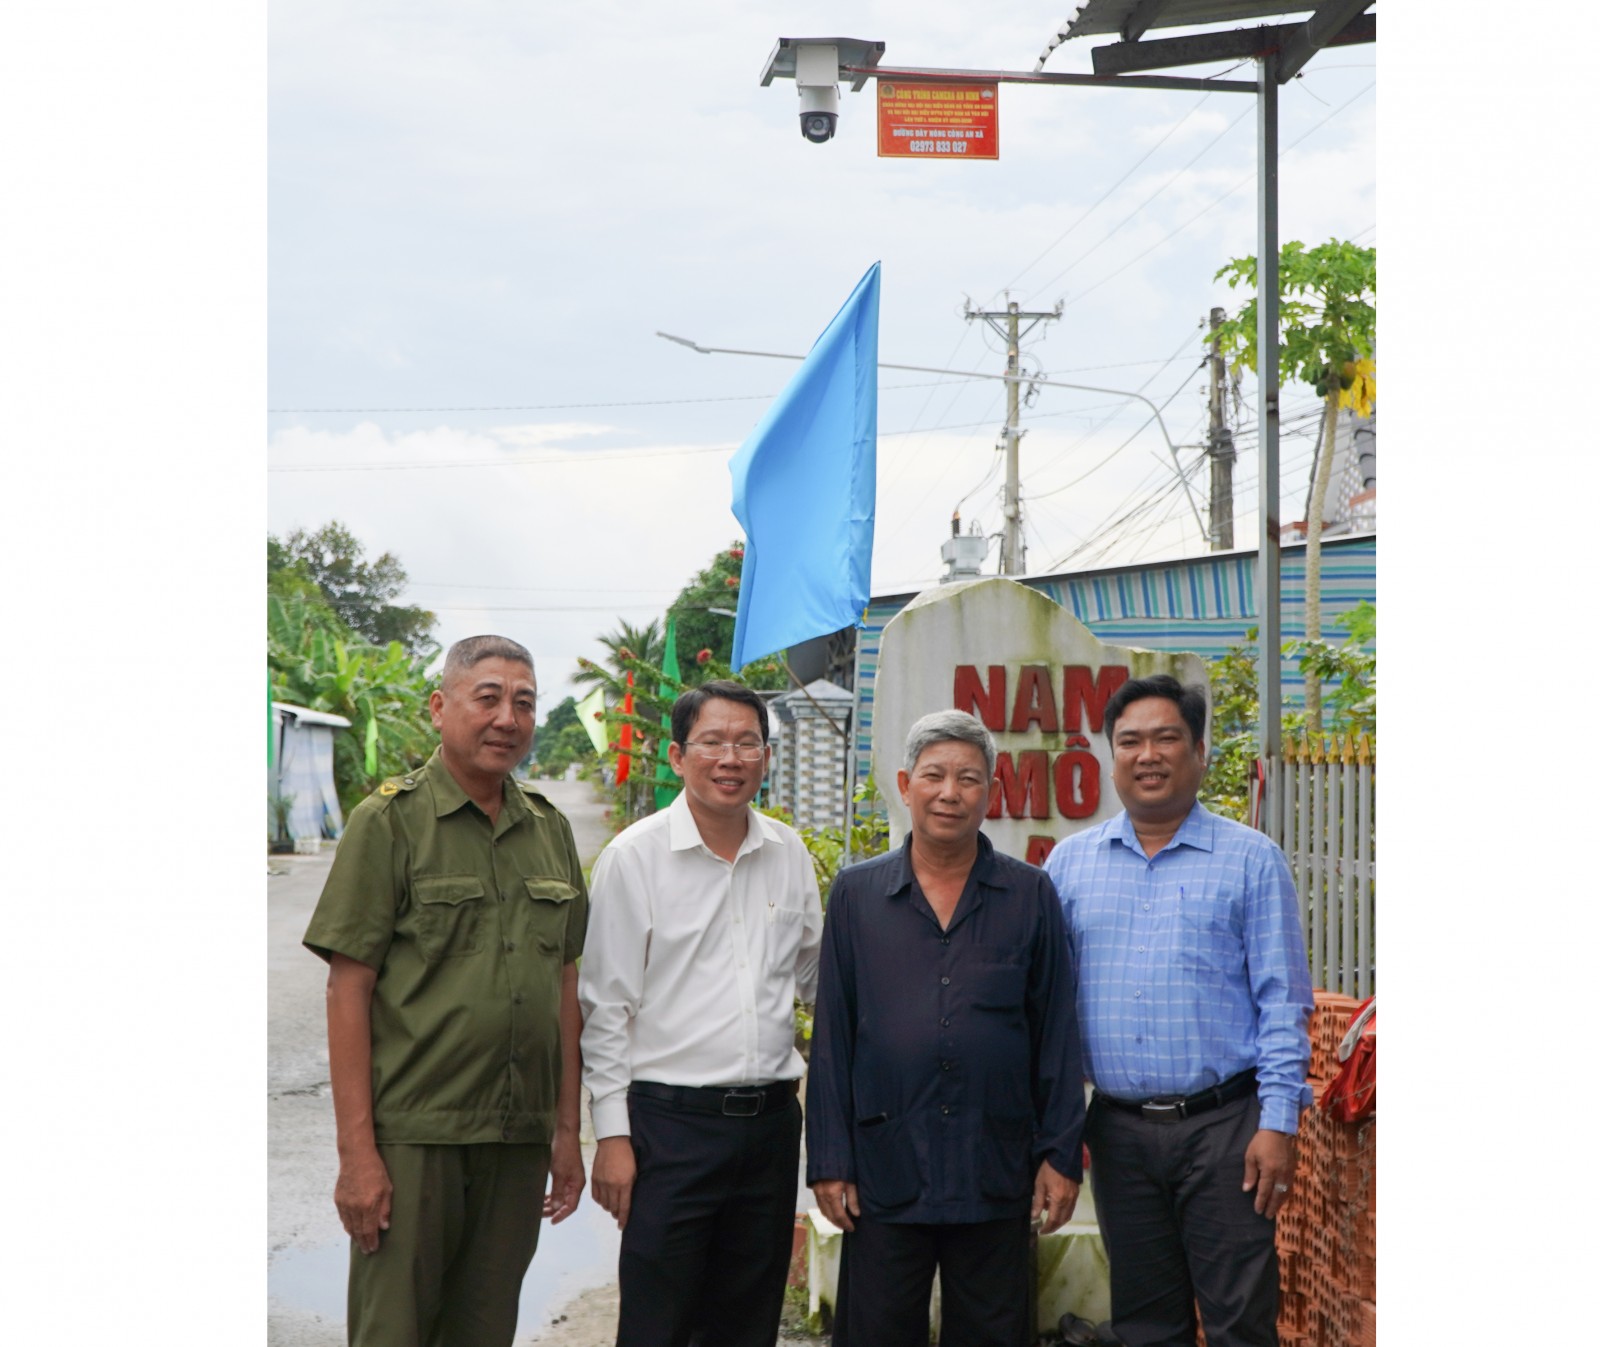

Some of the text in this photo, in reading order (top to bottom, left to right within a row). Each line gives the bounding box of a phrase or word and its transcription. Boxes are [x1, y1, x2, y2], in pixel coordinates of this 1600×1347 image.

[932, 91, 954, 100] CAMERA
[965, 130, 974, 138] AN
[910, 140, 967, 153] 02973 833 027
[954, 664, 1129, 733] NAM
[986, 734, 1101, 820] MÔ
